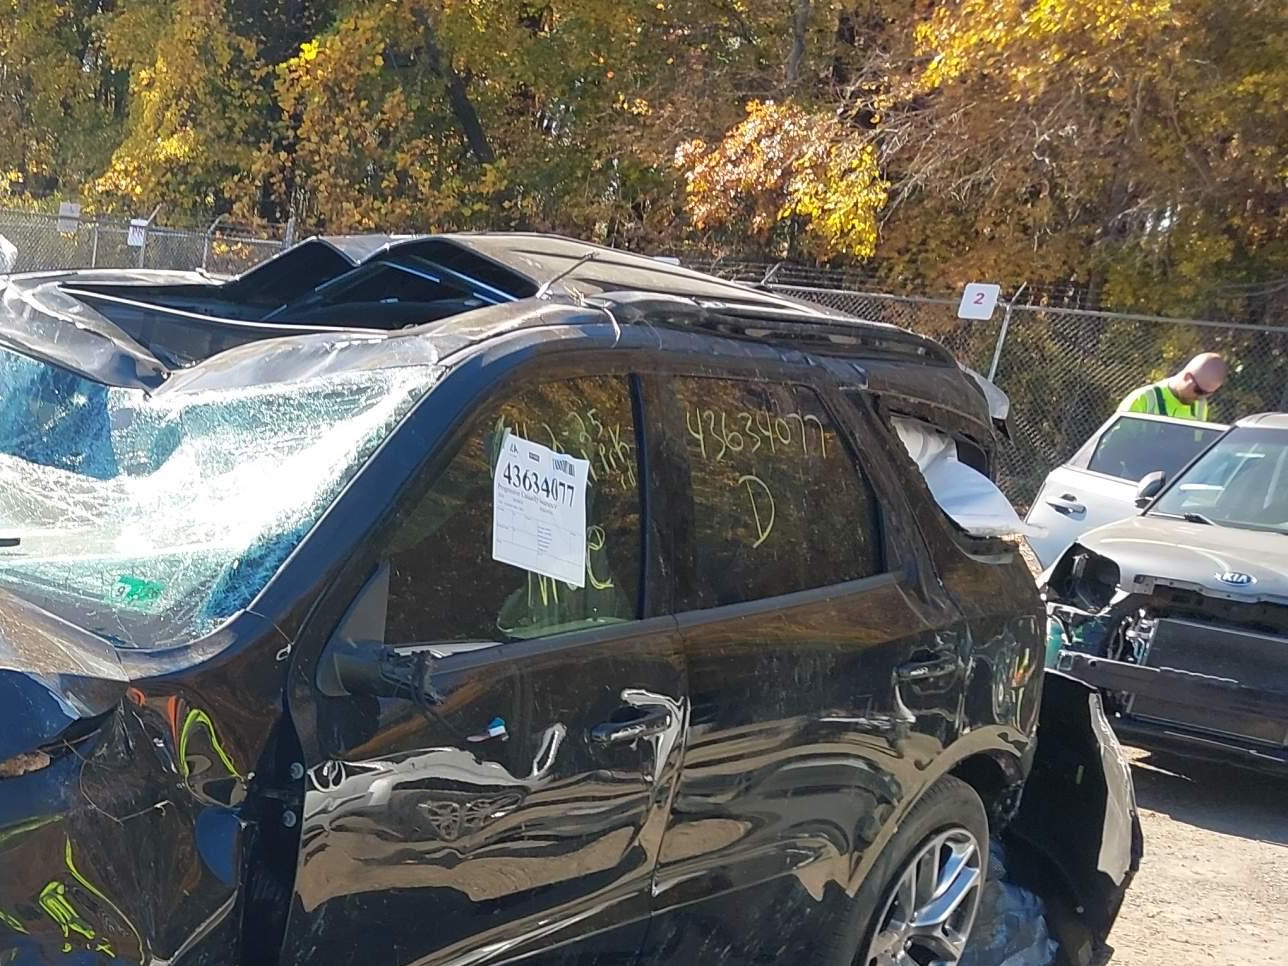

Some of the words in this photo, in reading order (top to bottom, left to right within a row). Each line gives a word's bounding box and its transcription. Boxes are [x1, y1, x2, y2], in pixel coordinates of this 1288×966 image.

[973, 292, 985, 305] 2
[686, 407, 826, 460] 43634077
[503, 462, 575, 508] 43634077
[738, 475, 775, 548] D
[1222, 572, 1248, 583] KIA
